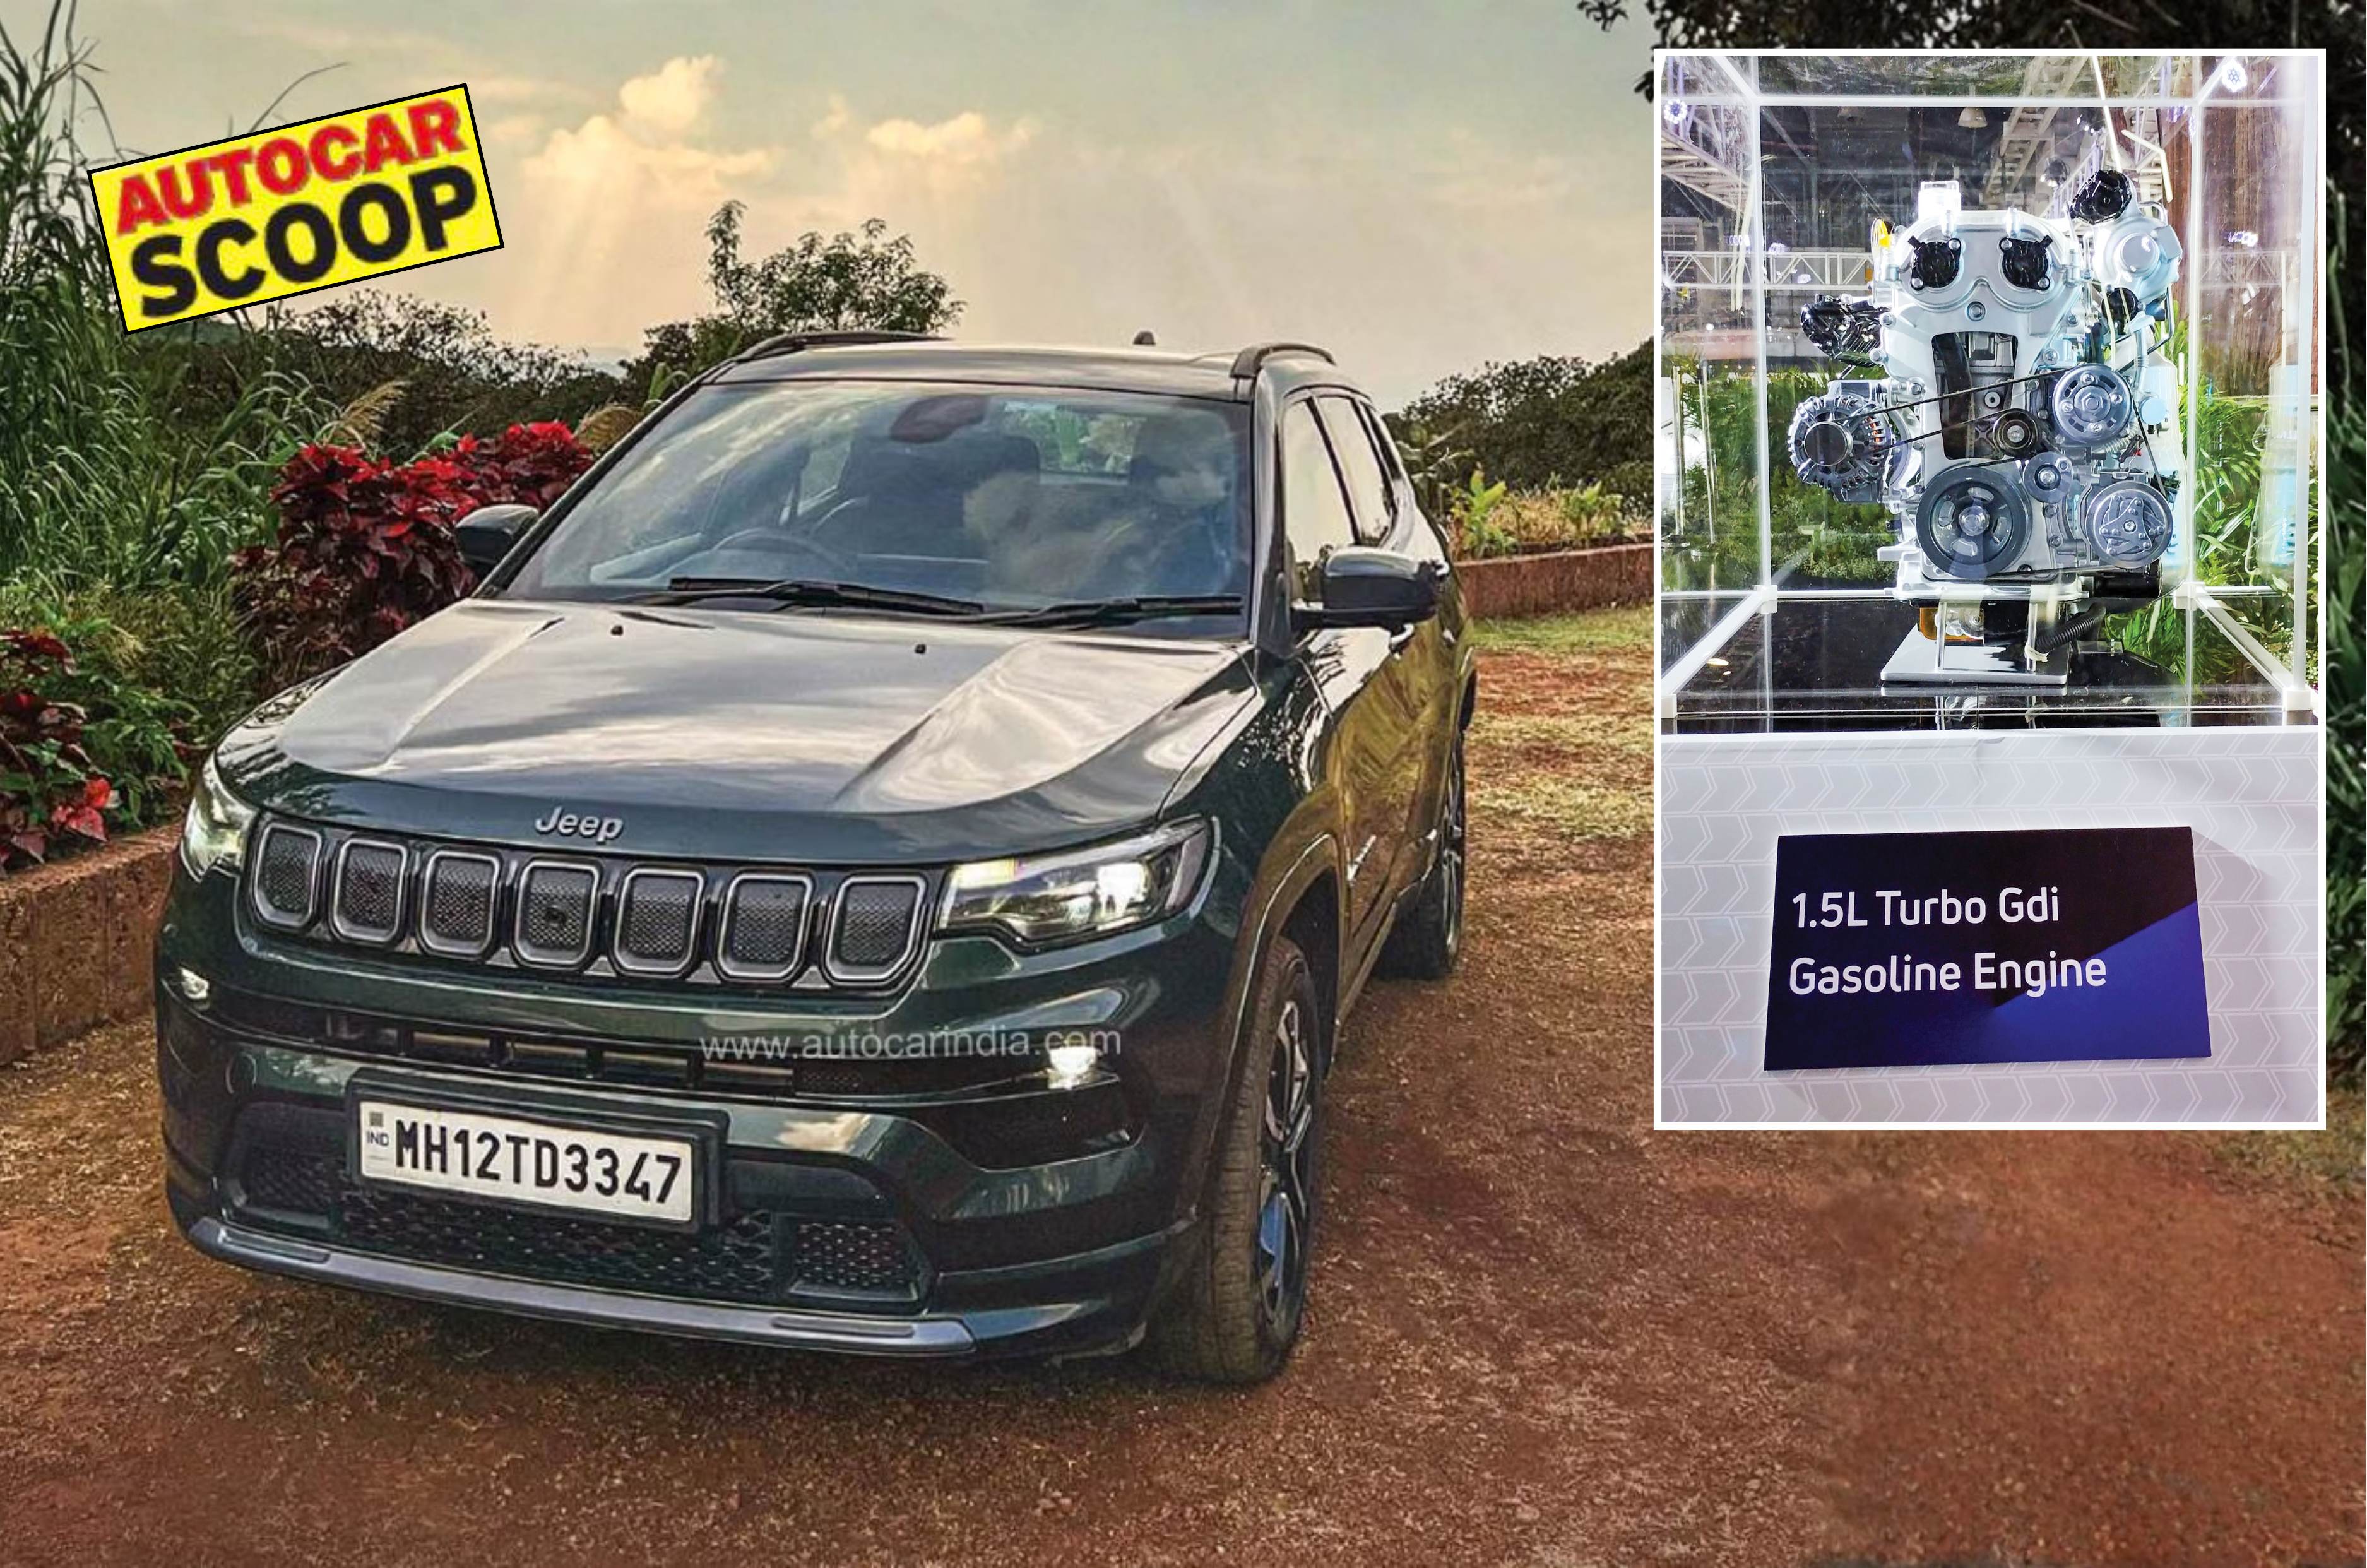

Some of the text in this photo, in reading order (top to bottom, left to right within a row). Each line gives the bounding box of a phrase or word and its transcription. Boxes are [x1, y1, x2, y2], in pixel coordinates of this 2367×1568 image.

[535, 806, 624, 843] Jeep
[1792, 886, 2059, 928] 1.5L Turbo Gdi
[1789, 950, 2106, 998] Gasoline Engine
[366, 1131, 389, 1147] IND
[395, 1119, 681, 1204] MH12TD3347
